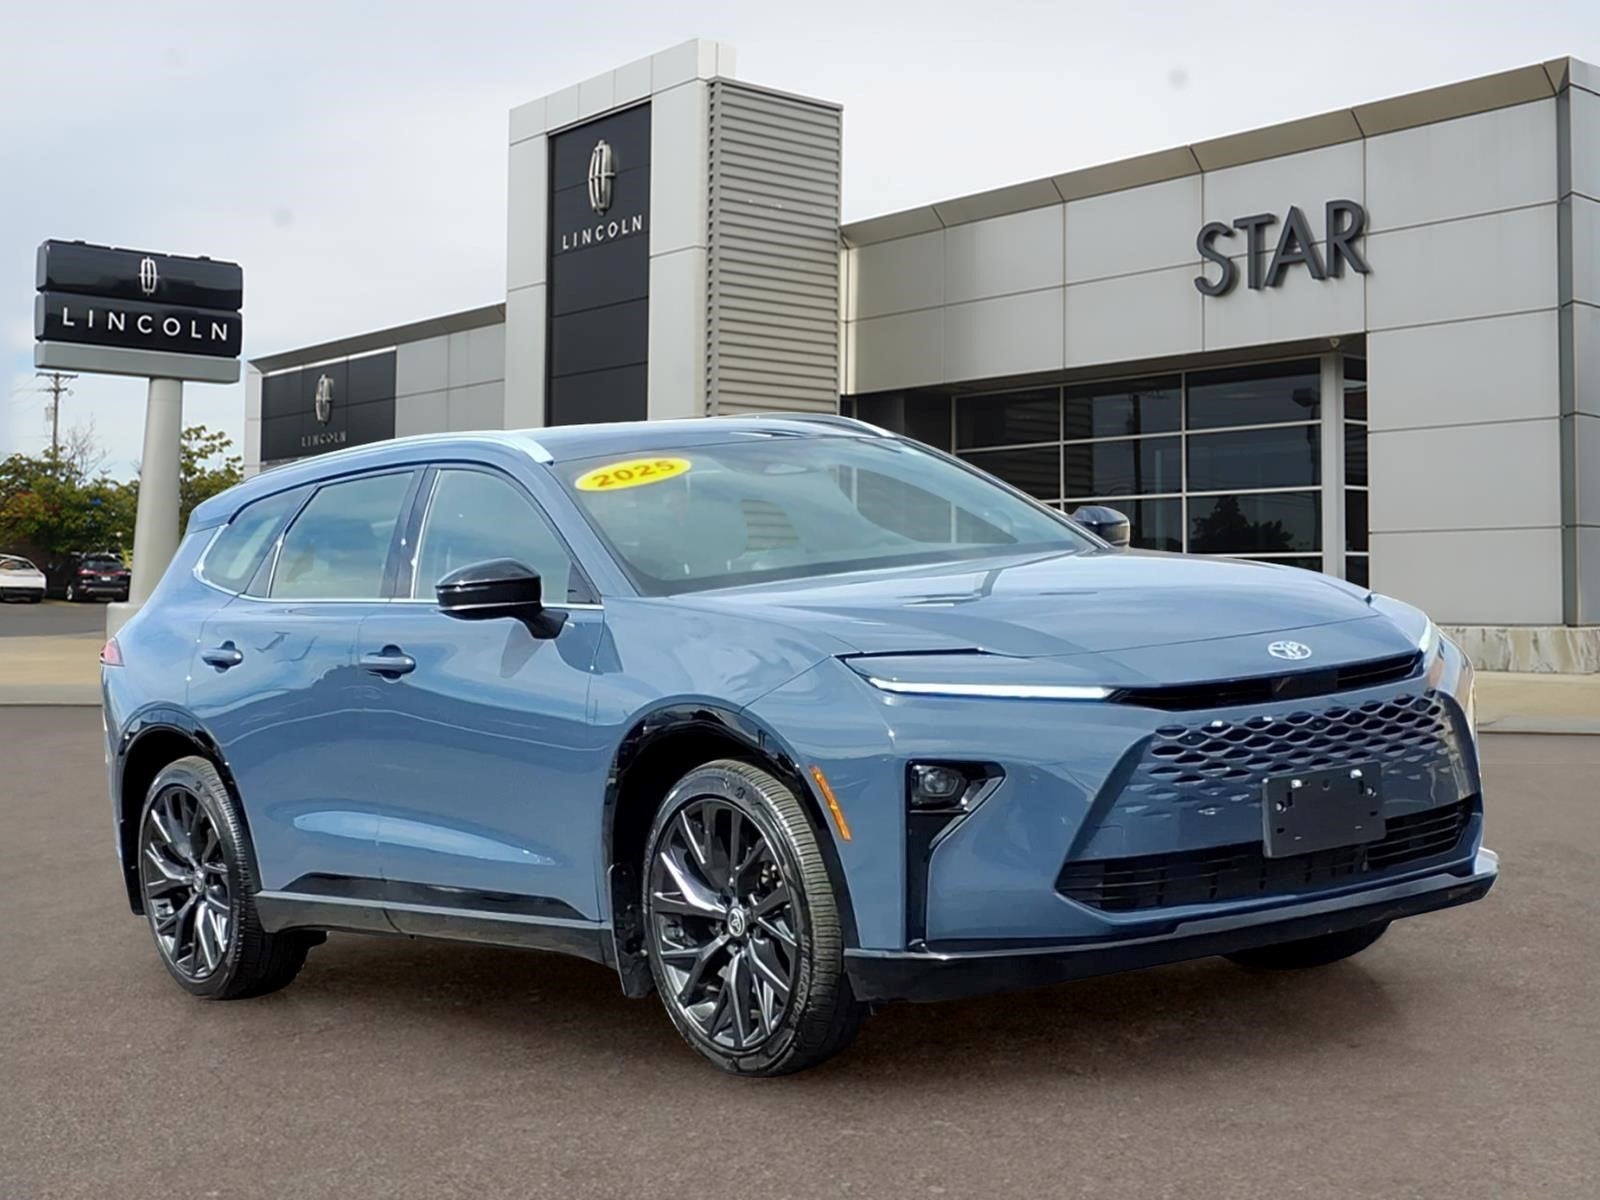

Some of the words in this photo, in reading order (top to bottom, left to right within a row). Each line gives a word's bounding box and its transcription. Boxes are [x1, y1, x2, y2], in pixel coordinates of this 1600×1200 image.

[562, 214, 642, 250] LINCOLN
[1194, 199, 1371, 297] STAR
[62, 307, 228, 342] LINCOLN
[301, 431, 346, 447] LINCOLN
[592, 461, 676, 487] 2025
